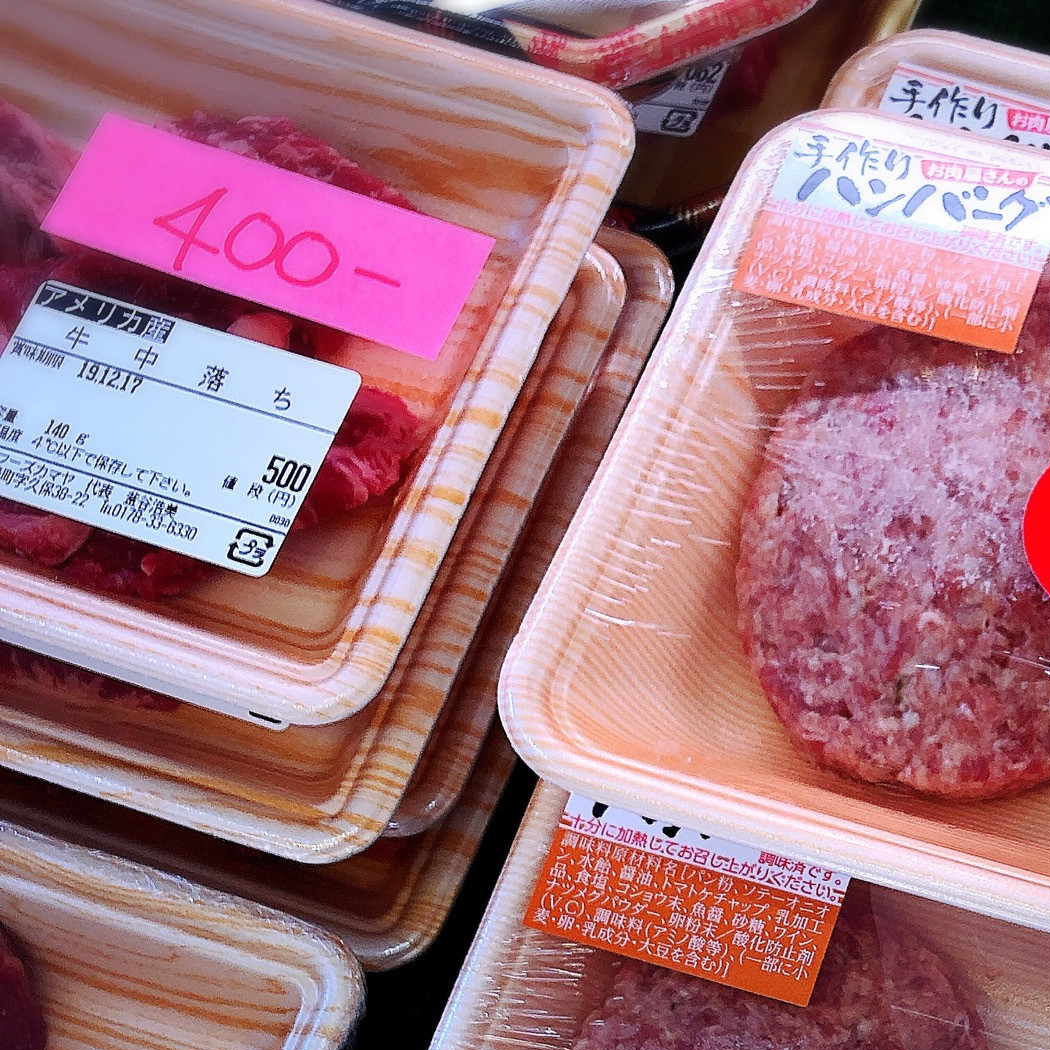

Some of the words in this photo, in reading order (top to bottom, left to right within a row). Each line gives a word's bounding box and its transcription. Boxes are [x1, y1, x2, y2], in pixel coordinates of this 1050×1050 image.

[890, 79, 998, 130] 手作り
[794, 134, 911, 180] 手作り
[928, 162, 1031, 188] お肉屋さんの
[36, 284, 174, 344] アメリカ産
[75, 359, 144, 395] 19.12.17
[44, 418, 70, 440] 140
[261, 455, 313, 494] 500
[758, 850, 844, 887] 調味済です。
